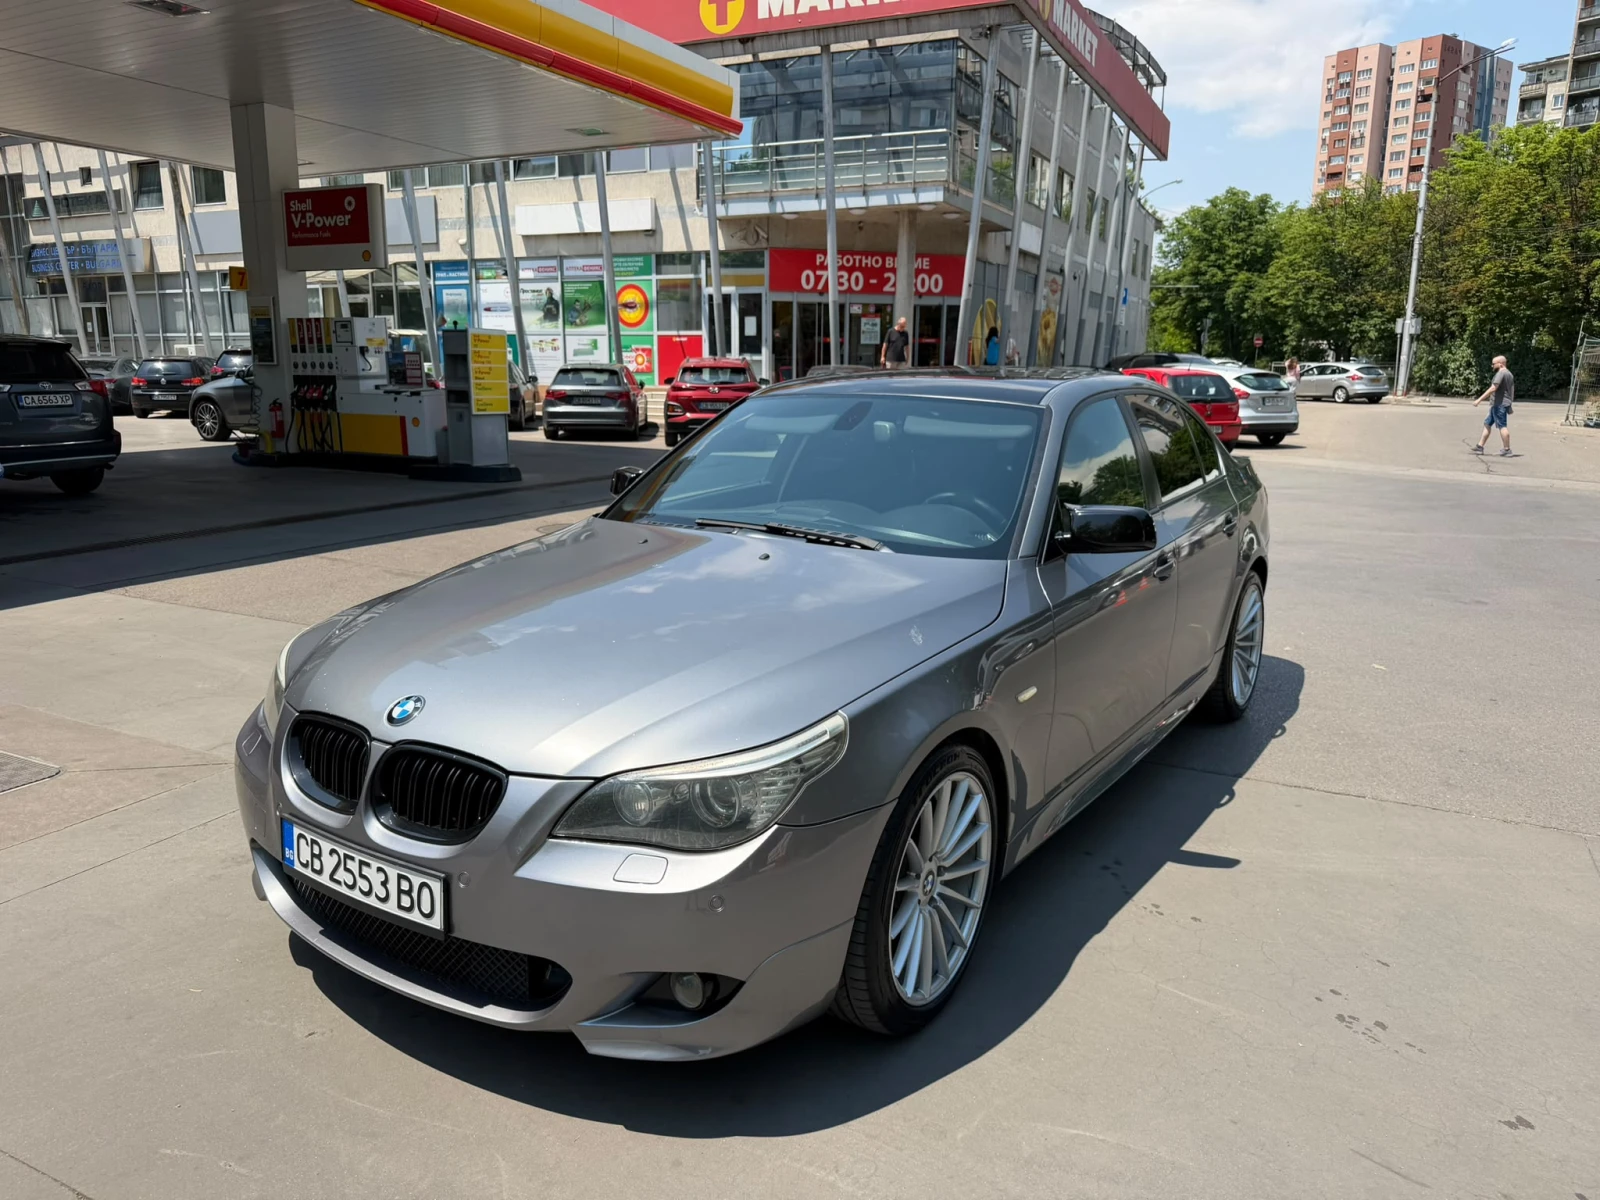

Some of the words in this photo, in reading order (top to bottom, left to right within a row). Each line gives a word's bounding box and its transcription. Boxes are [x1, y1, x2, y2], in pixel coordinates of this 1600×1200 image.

[1053, 0, 1098, 68] MARKET
[290, 198, 312, 211] Shell
[291, 211, 351, 228] V-Power
[81, 243, 119, 254] БЪЛГАРИ
[55, 261, 79, 271] CETER
[85, 259, 121, 269] BULGARI
[816, 254, 882, 268] РБОТНО
[885, 256, 930, 269] ВМЕ
[238, 272, 246, 286] 7
[800, 269, 864, 291] 0730
[38, 393, 58, 405] 6563
[60, 393, 71, 404] XP
[285, 847, 294, 861] BG
[296, 832, 323, 876] CB
[328, 848, 390, 903] 2553
